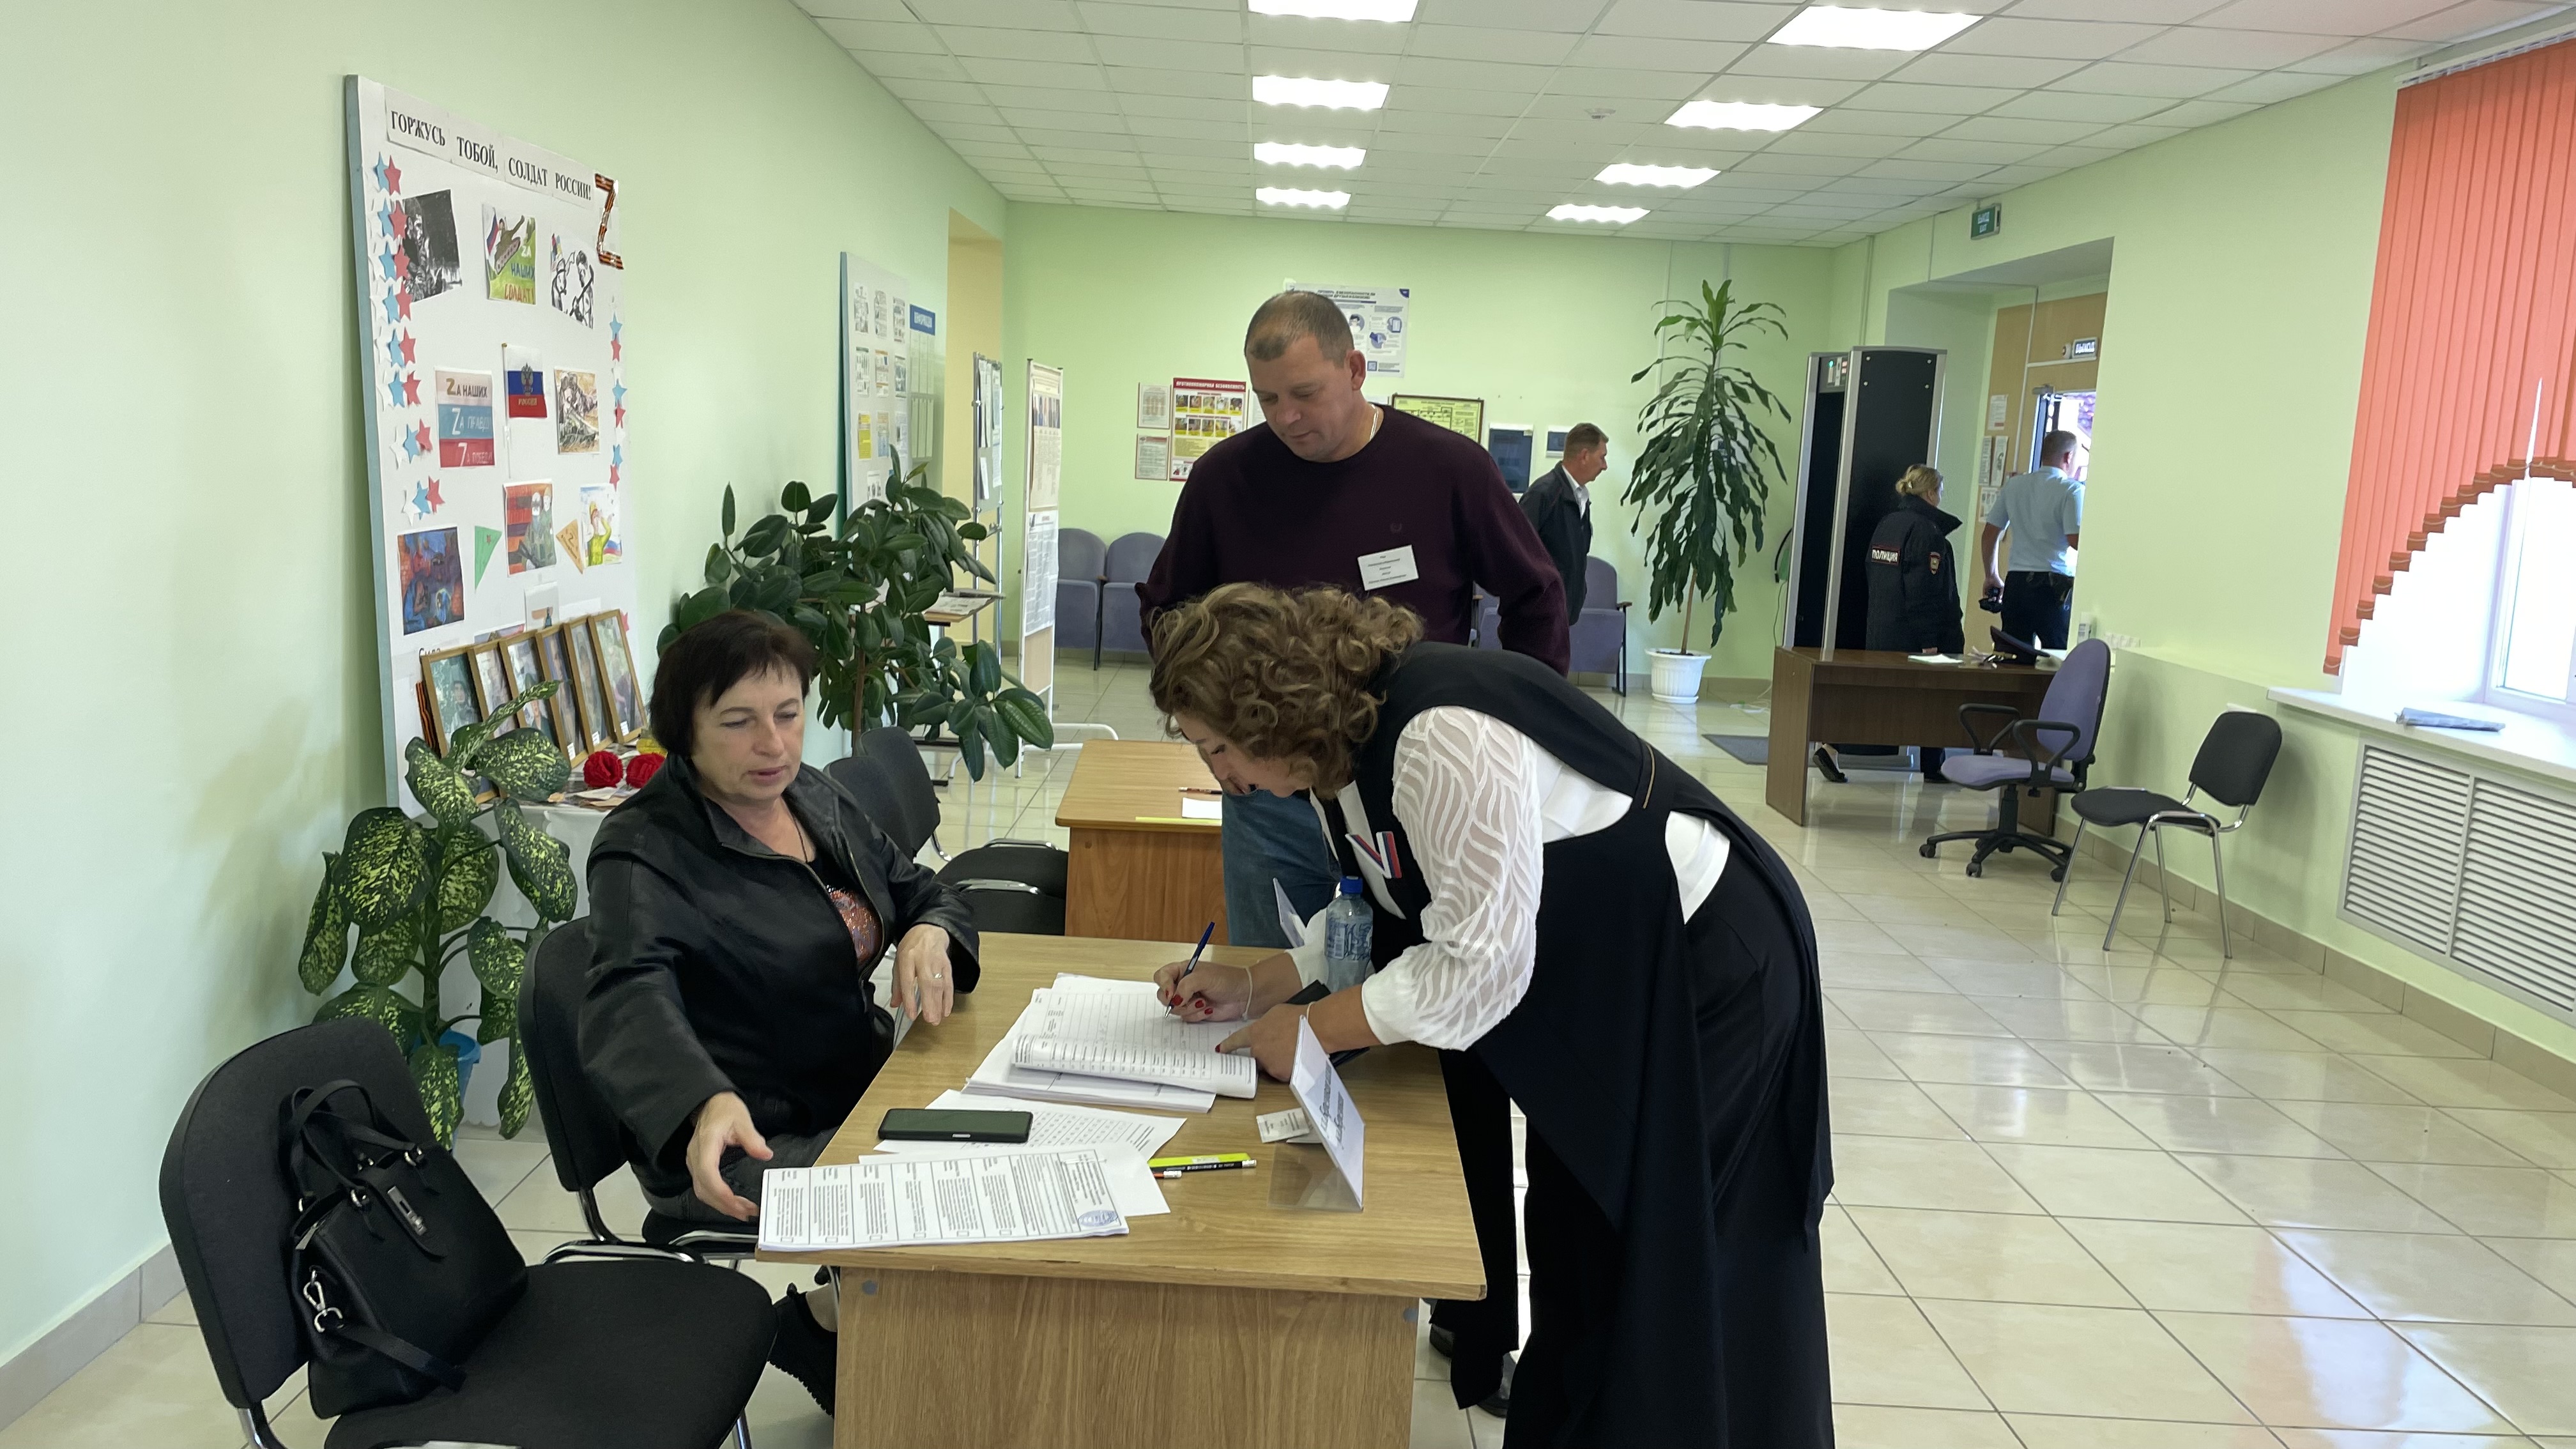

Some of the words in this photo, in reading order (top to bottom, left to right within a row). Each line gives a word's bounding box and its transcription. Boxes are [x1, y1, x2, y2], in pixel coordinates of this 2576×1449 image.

[391, 111, 445, 146] ГОРЖУСЬ
[457, 136, 498, 174] ТОБОЙ,
[509, 157, 548, 187] СОЛДАТ
[555, 172, 592, 201] РОССИИ!
[463, 384, 488, 398] НАШИХ
[1872, 549, 1899, 563] ПОЛИЦИЯ
